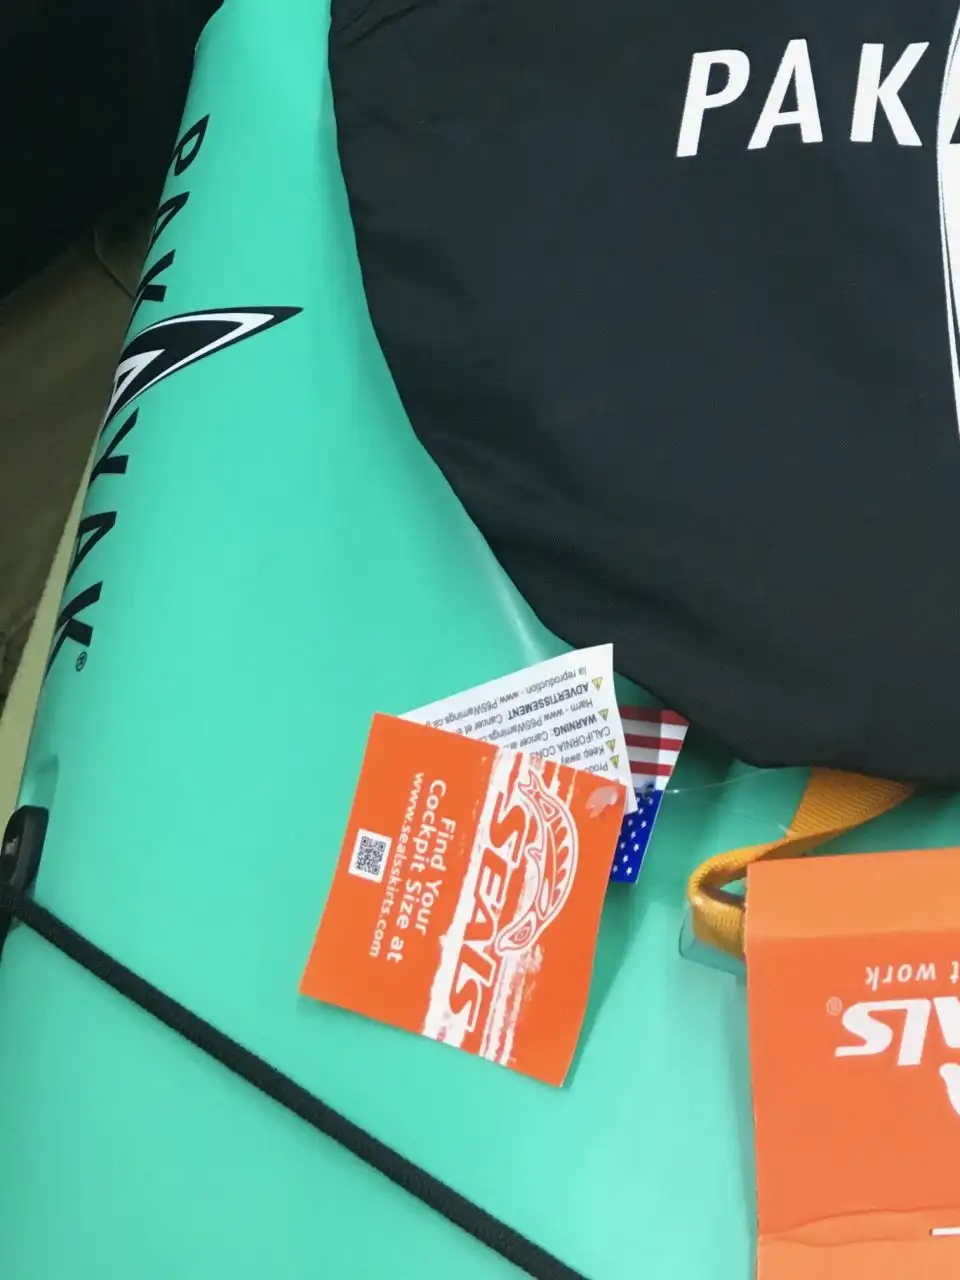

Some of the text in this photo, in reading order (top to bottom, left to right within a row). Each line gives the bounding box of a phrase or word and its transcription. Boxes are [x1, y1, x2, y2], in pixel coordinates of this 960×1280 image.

[526, 671, 577, 694] reproduction
[570, 698, 594, 712] Harm
[520, 730, 549, 747] Cancer
[557, 726, 611, 753] CALIFORNIA
[561, 745, 605, 765] Keep away
[368, 771, 425, 959] www.sealsskirts.com
[386, 779, 447, 964] Cockpit Size at
[414, 818, 457, 937] Find Your
[448, 790, 532, 1033] SEALS
[865, 963, 937, 991] work
